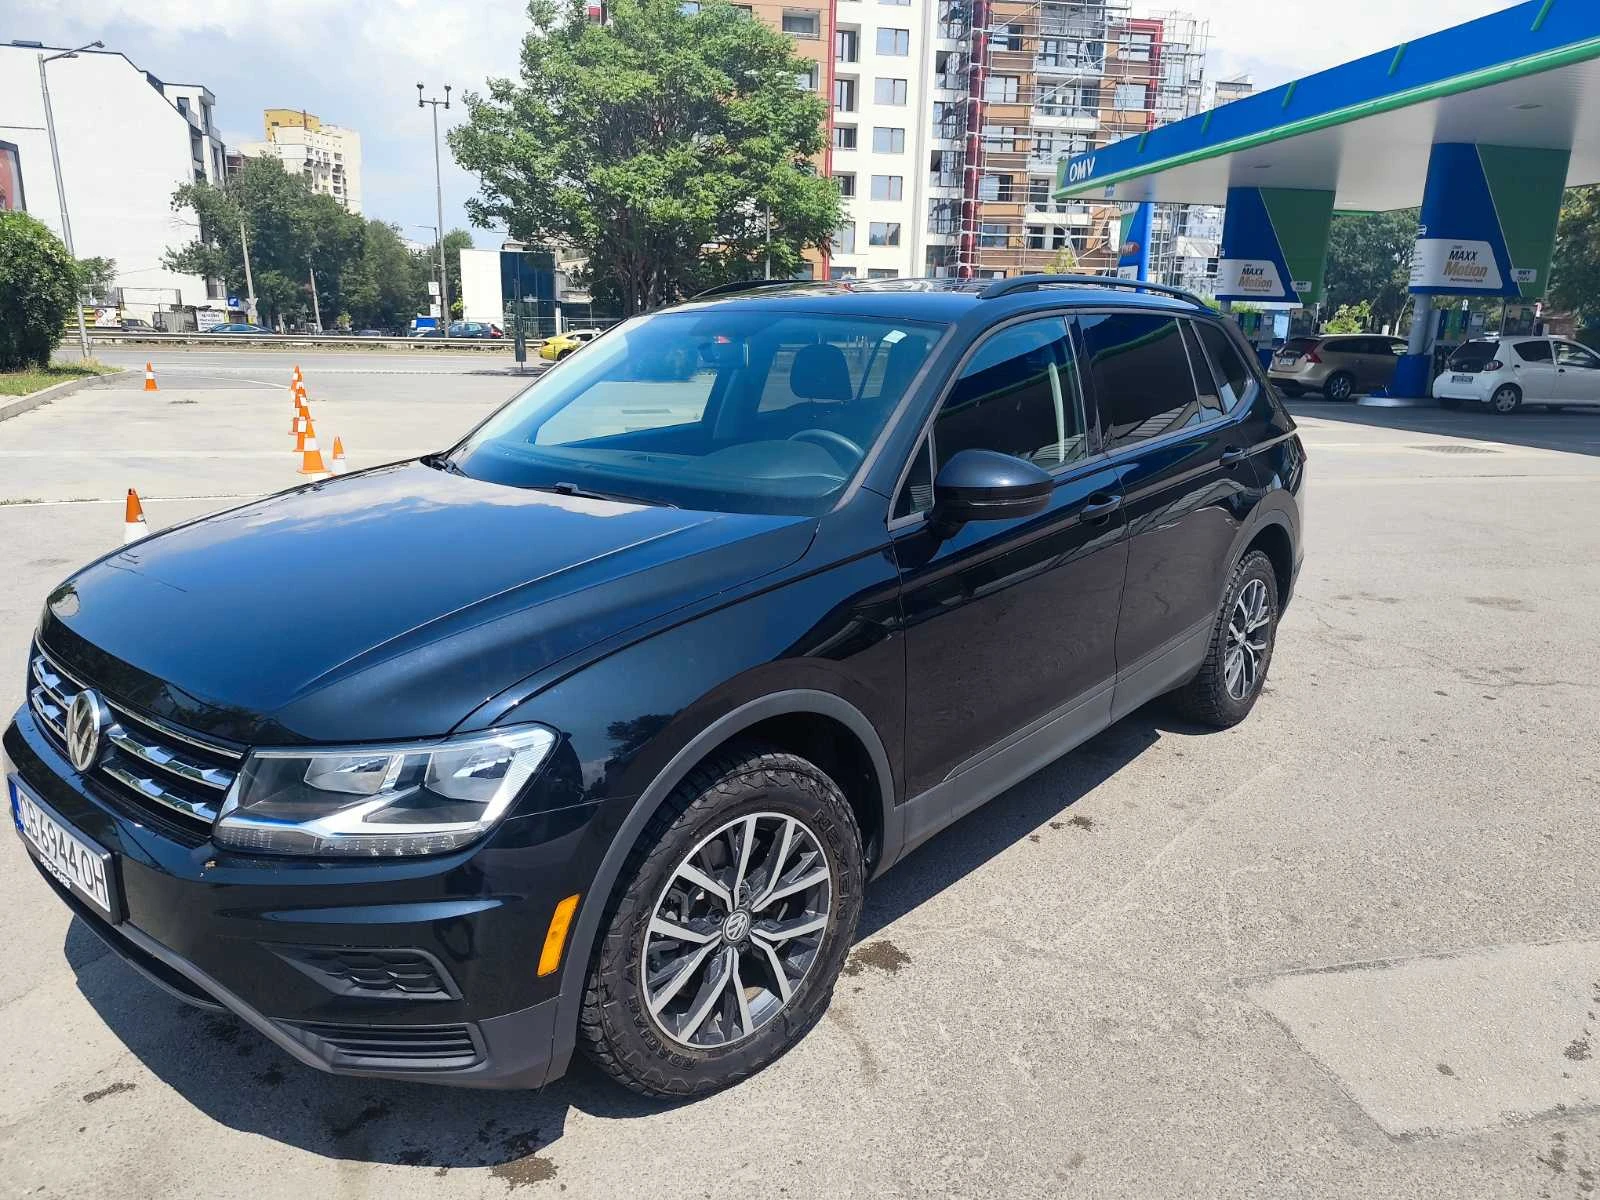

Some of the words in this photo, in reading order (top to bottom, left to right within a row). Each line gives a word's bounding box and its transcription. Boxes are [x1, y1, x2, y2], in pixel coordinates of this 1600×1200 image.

[1069, 156, 1096, 183] OMV
[1449, 250, 1478, 261] MAXX
[1241, 267, 1265, 276] MAXX
[1443, 261, 1488, 278] Motion
